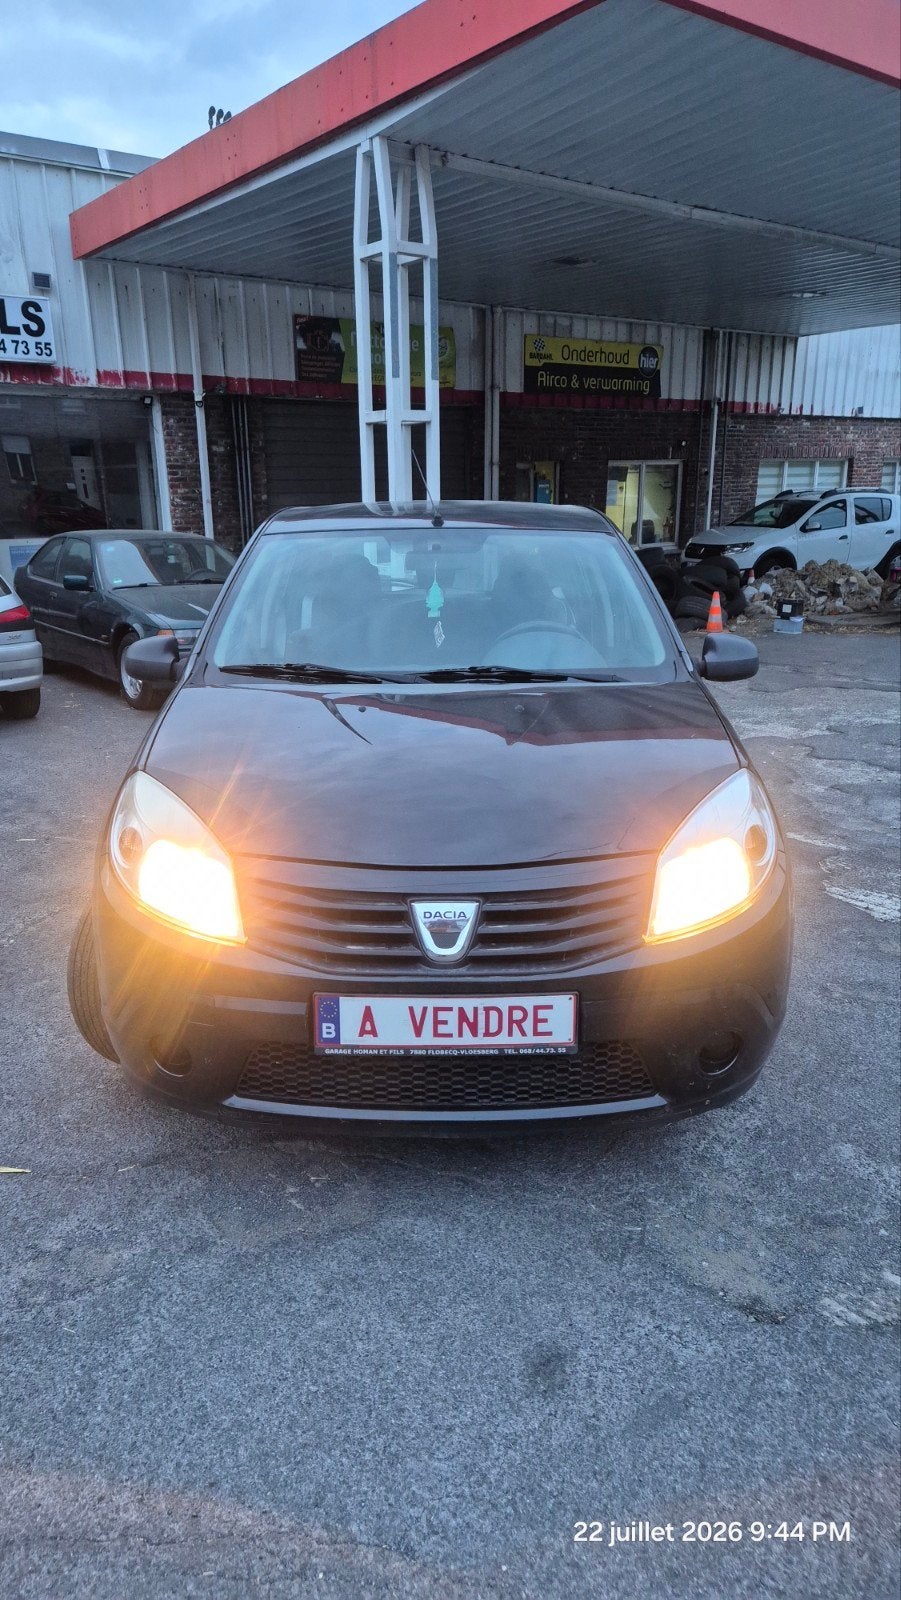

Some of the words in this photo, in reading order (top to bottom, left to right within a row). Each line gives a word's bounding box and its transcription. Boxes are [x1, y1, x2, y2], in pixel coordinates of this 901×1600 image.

[11, 339, 30, 355] 73
[35, 341, 53, 357] 55
[561, 344, 630, 365] Onderhoud
[640, 353, 658, 368] hier
[537, 371, 567, 388] Airco
[570, 374, 580, 388] &
[583, 377, 650, 395] verwarming
[423, 911, 467, 919] DACIA
[321, 1023, 336, 1039] B
[358, 1005, 379, 1038] A
[408, 1004, 554, 1038] VENDRE
